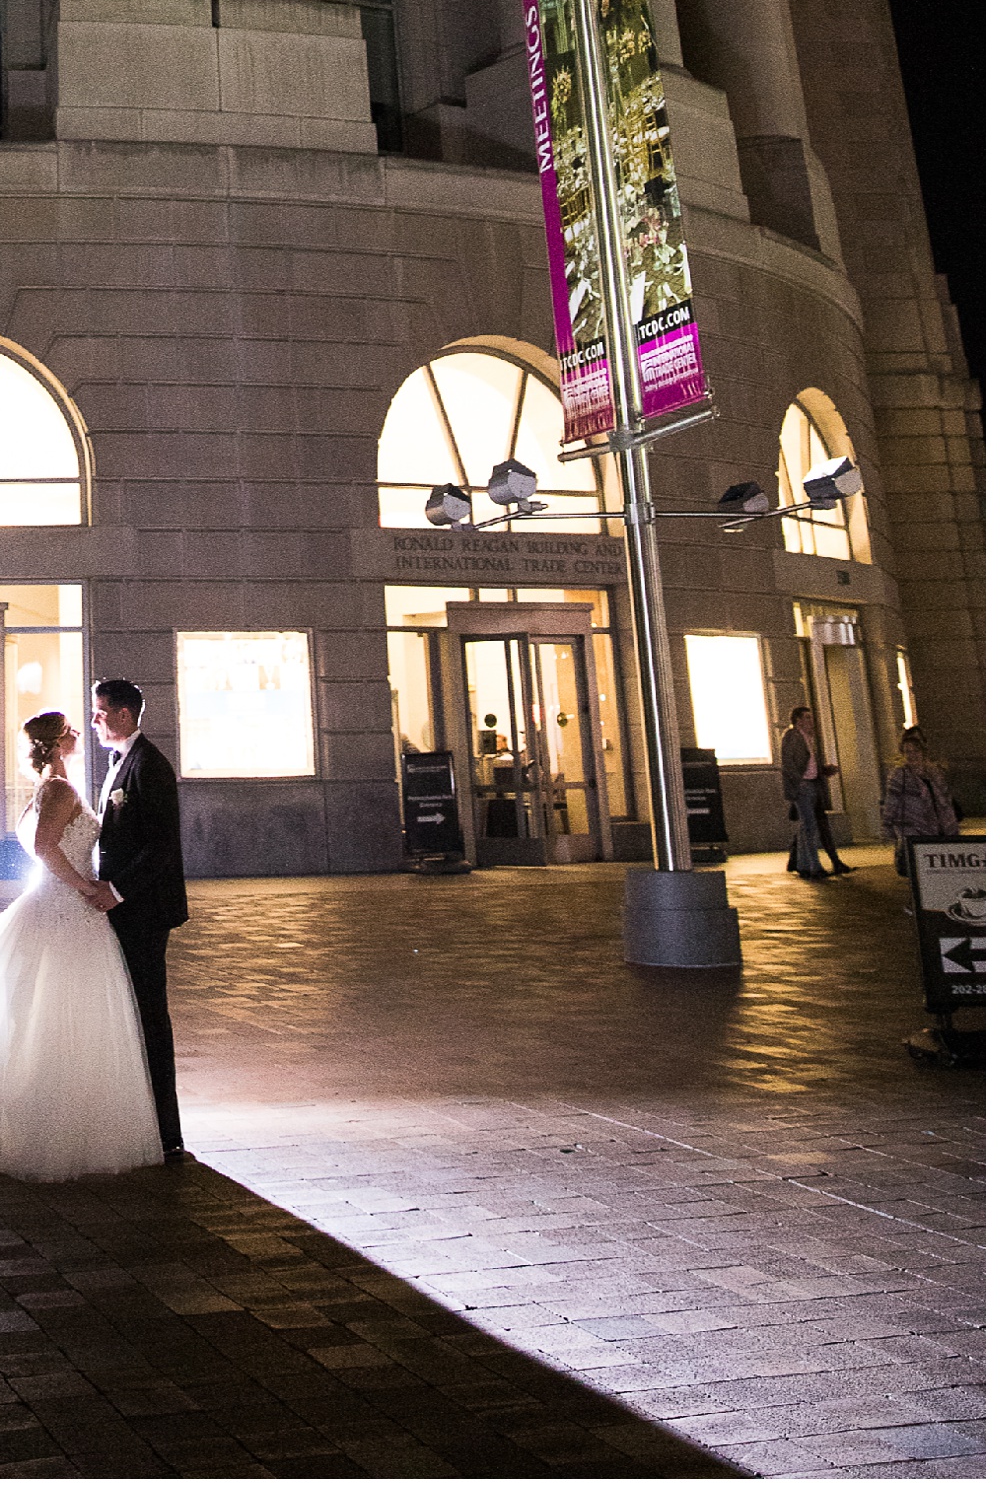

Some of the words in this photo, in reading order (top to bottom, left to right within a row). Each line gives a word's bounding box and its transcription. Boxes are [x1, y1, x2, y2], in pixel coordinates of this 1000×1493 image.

[524, 6, 552, 174] MEETINGS
[560, 341, 605, 371] ITCDCCOM
[393, 536, 454, 553] RONALD
[462, 538, 520, 554] REAGAN
[527, 540, 588, 556] BUILDING
[595, 542, 623, 557] AND
[395, 556, 515, 572] INTERNATIONAL
[523, 558, 569, 573] TRADE
[574, 560, 624, 575] CENTER
[922, 852, 986, 868] TIMG
